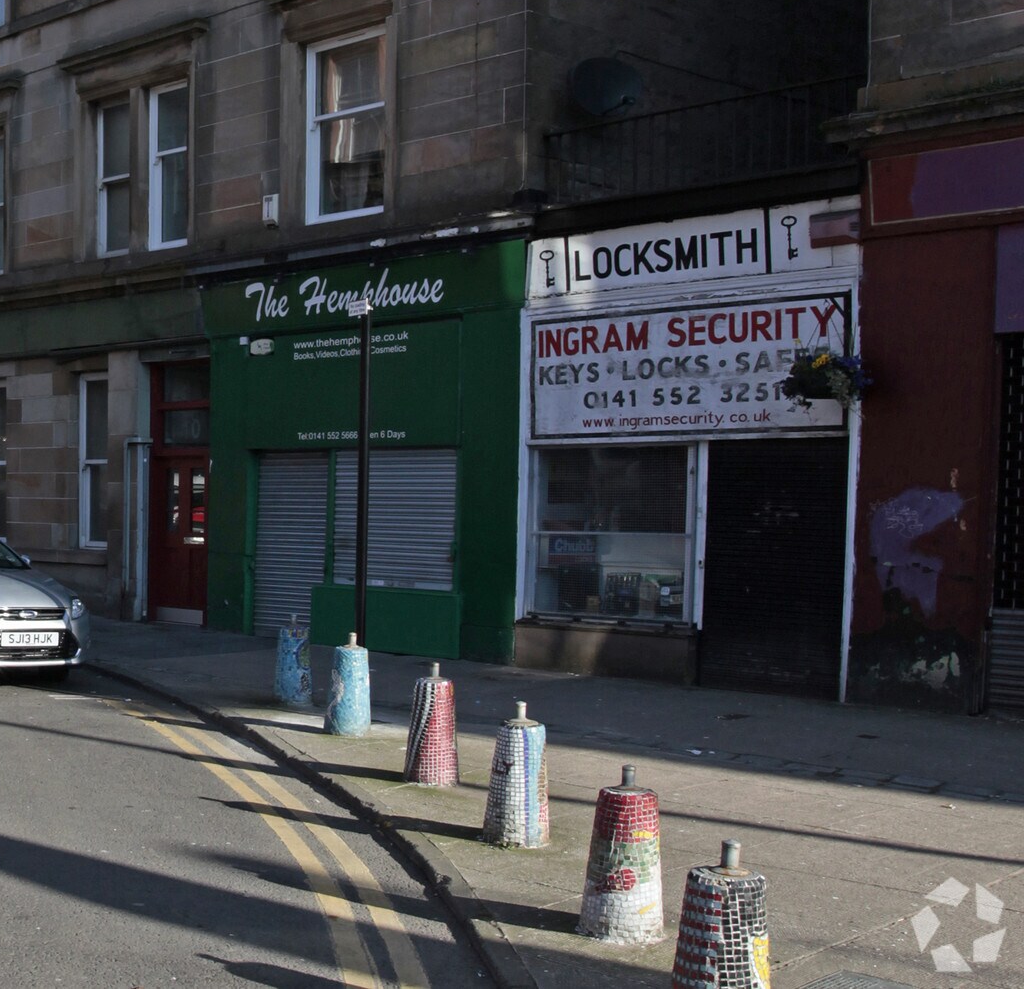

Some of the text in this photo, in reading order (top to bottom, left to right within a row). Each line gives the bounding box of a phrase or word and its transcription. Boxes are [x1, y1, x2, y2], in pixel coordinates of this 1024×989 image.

[574, 228, 758, 281] LOCKSMITH
[245, 281, 289, 322] The
[293, 331, 408, 349] www.thehemphse.co.uk
[538, 305, 836, 358] INGRAM SECURITY
[539, 362, 599, 386] KEYS
[622, 354, 710, 381] LOCKS
[583, 382, 782, 410] 0141 552 3251
[327, 431, 340, 440] 552
[387, 430, 406, 440] Days
[9, 633, 53, 644] SJ13 HJK
